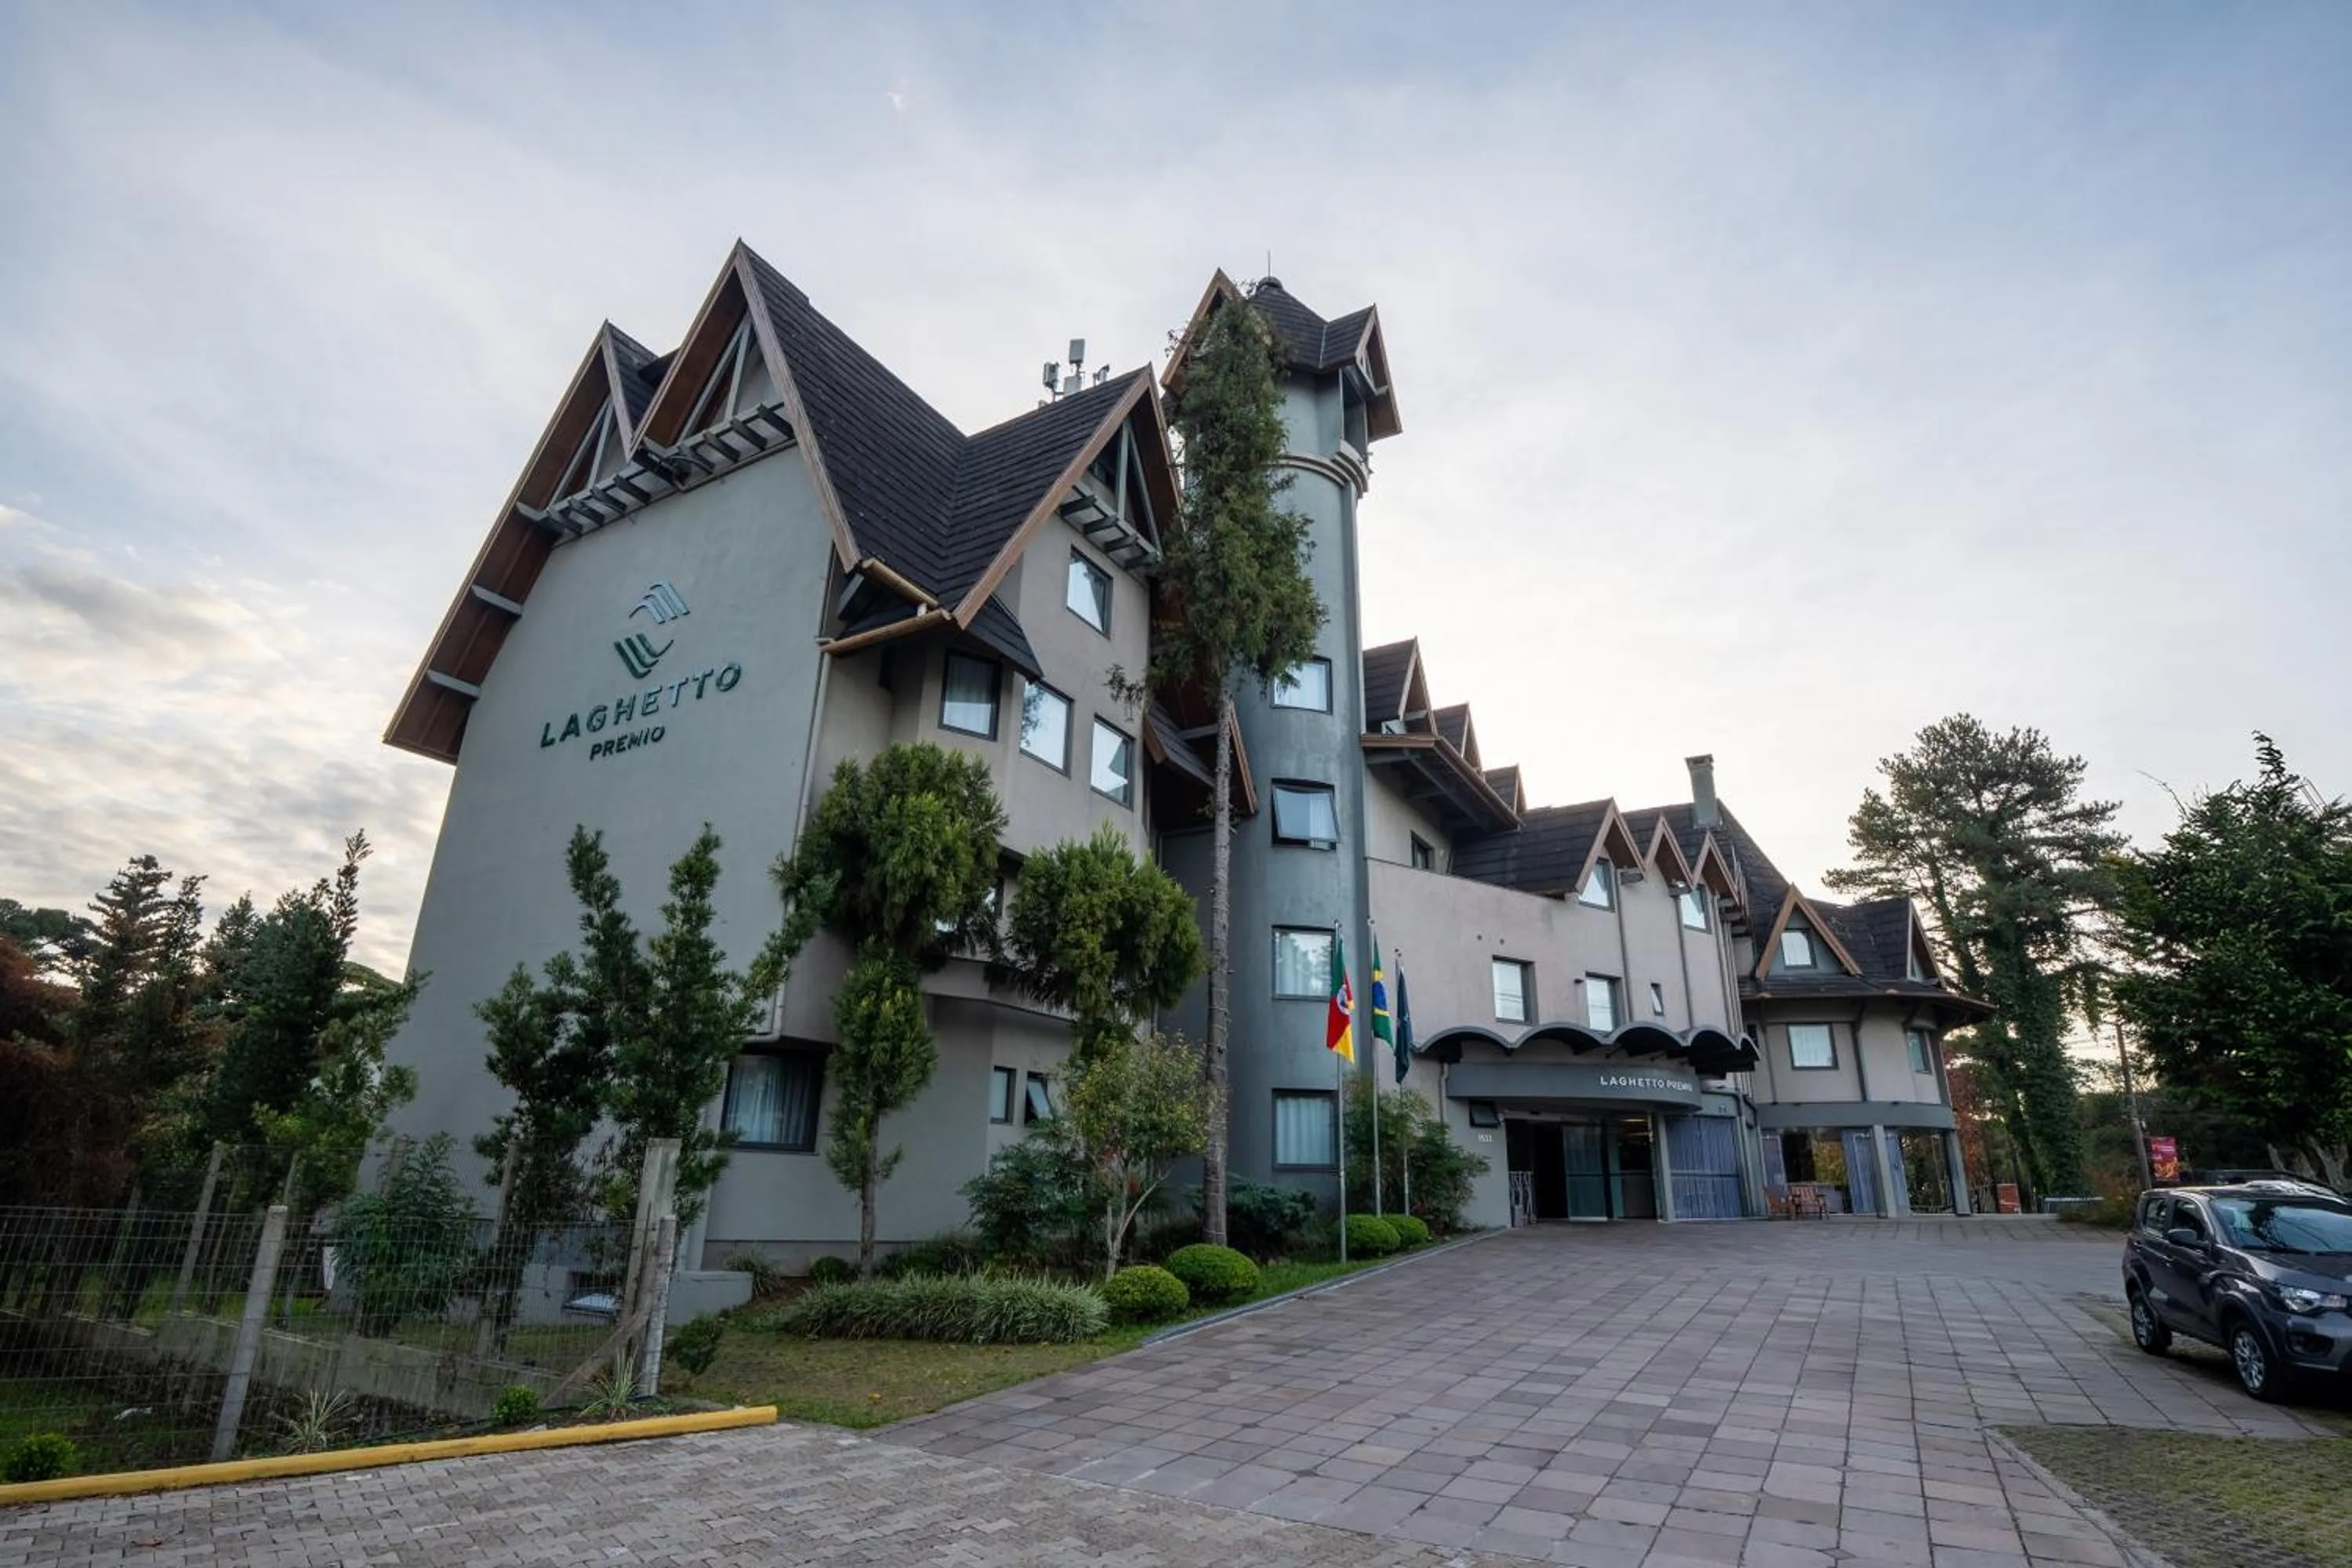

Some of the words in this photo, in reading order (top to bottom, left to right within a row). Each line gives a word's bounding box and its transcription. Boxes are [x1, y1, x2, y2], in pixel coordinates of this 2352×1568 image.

[540, 662, 742, 748] LAGHETTO
[590, 725, 666, 761] PREMIO
[1600, 1076, 1664, 1088] LAGHETTO
